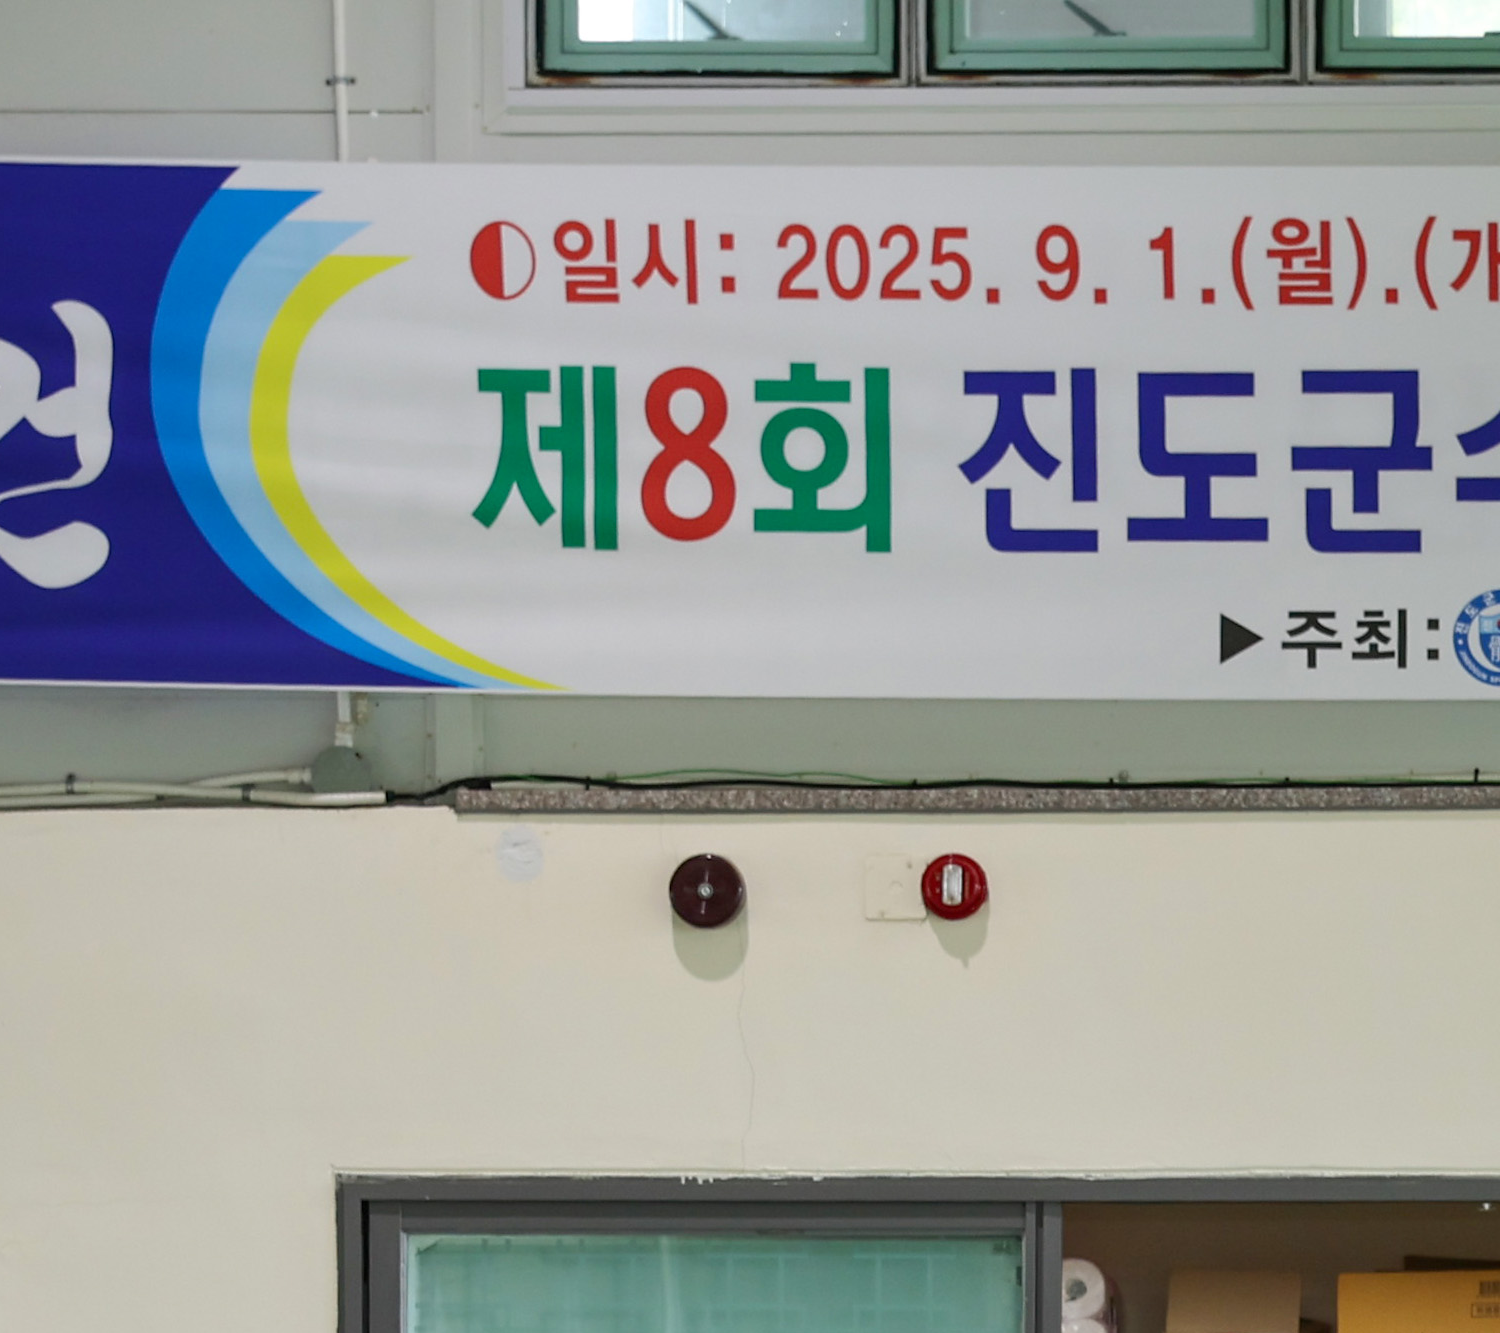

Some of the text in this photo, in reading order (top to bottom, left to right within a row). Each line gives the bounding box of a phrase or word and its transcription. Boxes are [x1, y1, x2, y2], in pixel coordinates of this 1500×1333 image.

[552, 217, 737, 306] 일시:
[777, 223, 1000, 304] 2025.
[1035, 224, 1108, 304] 9.
[471, 362, 893, 554] 제8회
[1281, 608, 1441, 670] 주최:
